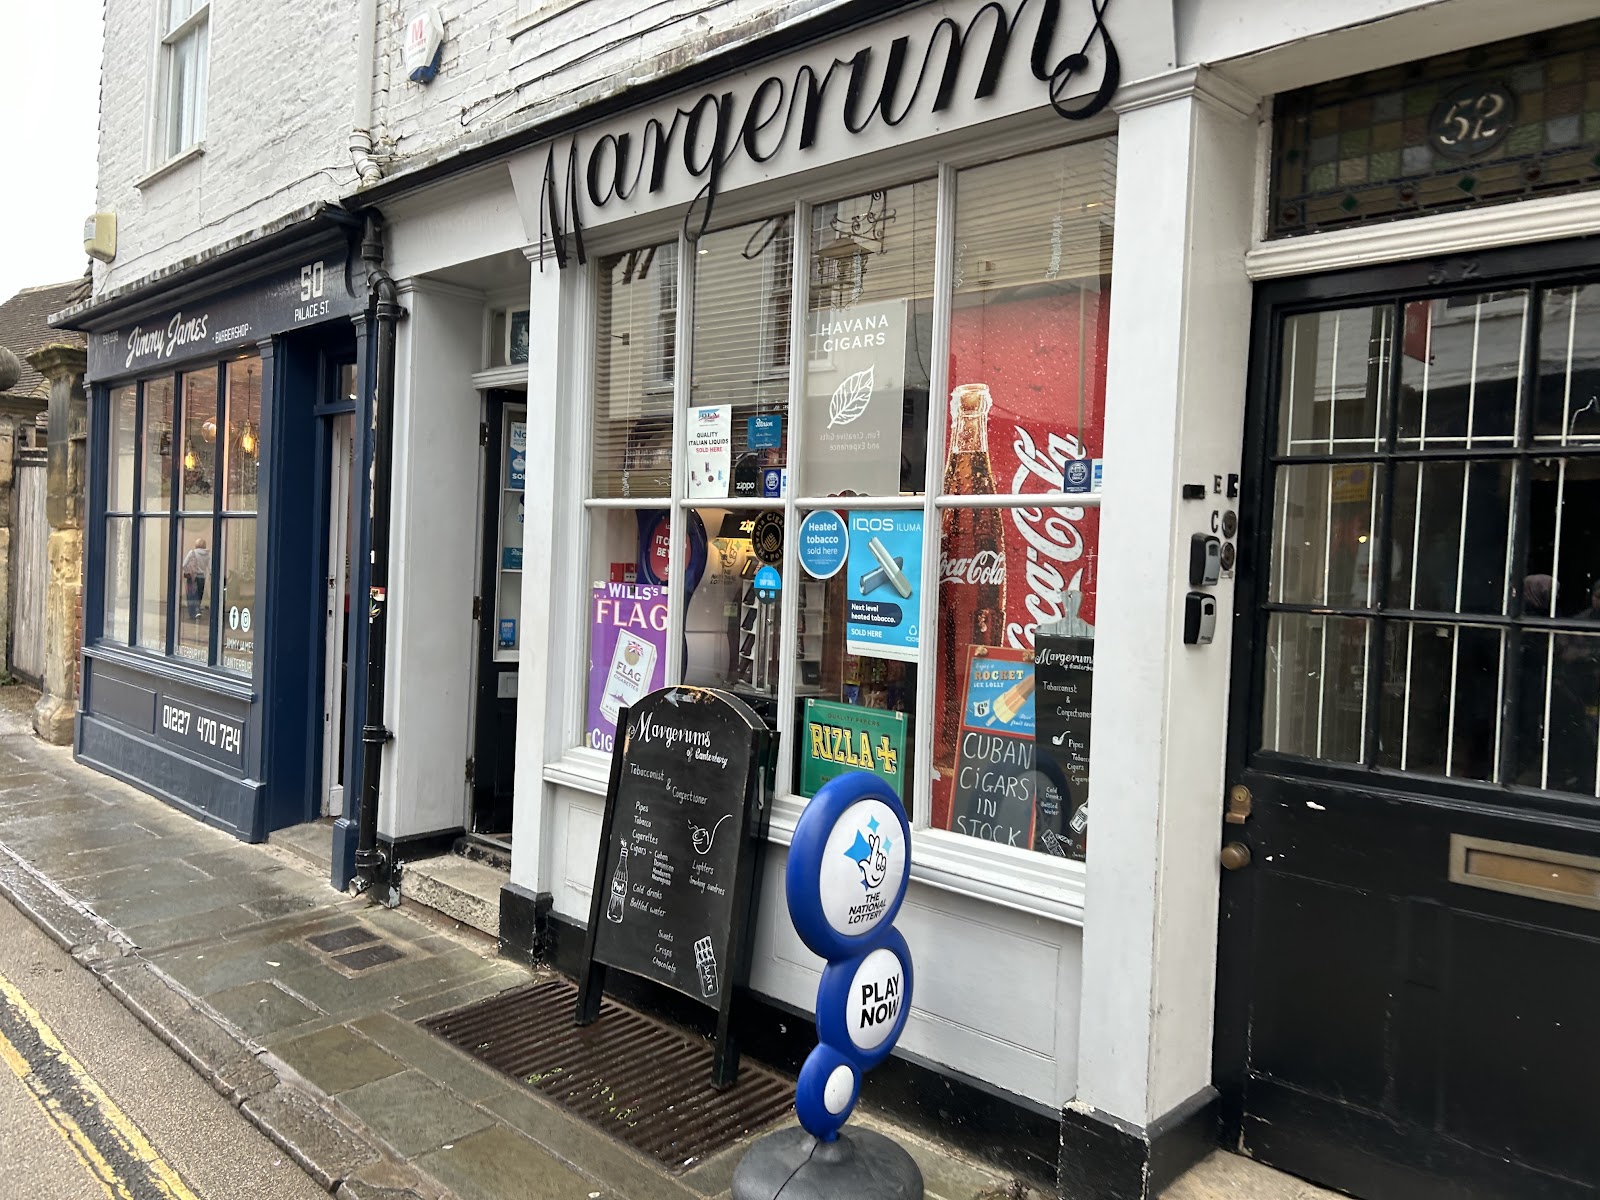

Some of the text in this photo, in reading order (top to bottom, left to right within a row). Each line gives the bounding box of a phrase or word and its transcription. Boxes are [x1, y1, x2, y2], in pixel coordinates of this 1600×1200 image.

[1440, 93, 1504, 145] 52
[300, 261, 324, 302] 50
[294, 303, 318, 322] PALACE
[214, 324, 250, 344] BARBERSHOP
[821, 315, 889, 336] HAVANA
[125, 311, 209, 368] Jimmy James
[823, 332, 886, 353] CIGARS
[736, 481, 755, 491] zippo
[1213, 475, 1222, 494] E
[808, 522, 838, 532] Heated
[853, 517, 922, 533] IQOS ILUMA
[806, 535, 839, 544] tobacco
[807, 546, 838, 555] sold here
[595, 598, 669, 632] FLAG
[851, 603, 879, 613] Next level
[851, 612, 896, 624] heated tobacco.
[851, 628, 883, 639] SOLD HERE
[616, 661, 642, 683] FLAG
[974, 669, 1024, 681] ROCKET
[613, 673, 640, 693] CIGARETTES
[1065, 695, 1071, 704] &
[828, 713, 880, 726] QUALITY PAPERS
[163, 704, 241, 755] 01227 470 724
[963, 732, 1033, 770] CUBAN
[1068, 738, 1084, 751] Pipes
[686, 747, 728, 769] of Canterbury
[630, 762, 708, 805] Tobacconist & Confectioner
[1046, 786, 1058, 794] Cold
[635, 800, 649, 815] Pipes
[633, 815, 652, 828] Tobacco
[632, 829, 659, 845] Cigarettes
[957, 815, 1022, 847] STOCK
[630, 842, 647, 856] Cigars
[691, 860, 715, 877] Lighters
[632, 883, 663, 900] Cold drinks
[865, 892, 881, 904] THE
[629, 897, 667, 917] Bottled water
[848, 899, 887, 916] NATIONAL
[848, 910, 883, 925] LOTTERY
[657, 929, 674, 942] Sweets
[654, 943, 673, 959] Crisps
[652, 956, 677, 974] Chocolate
[861, 973, 900, 1006] PLAY
[860, 1000, 900, 1029] NOW
